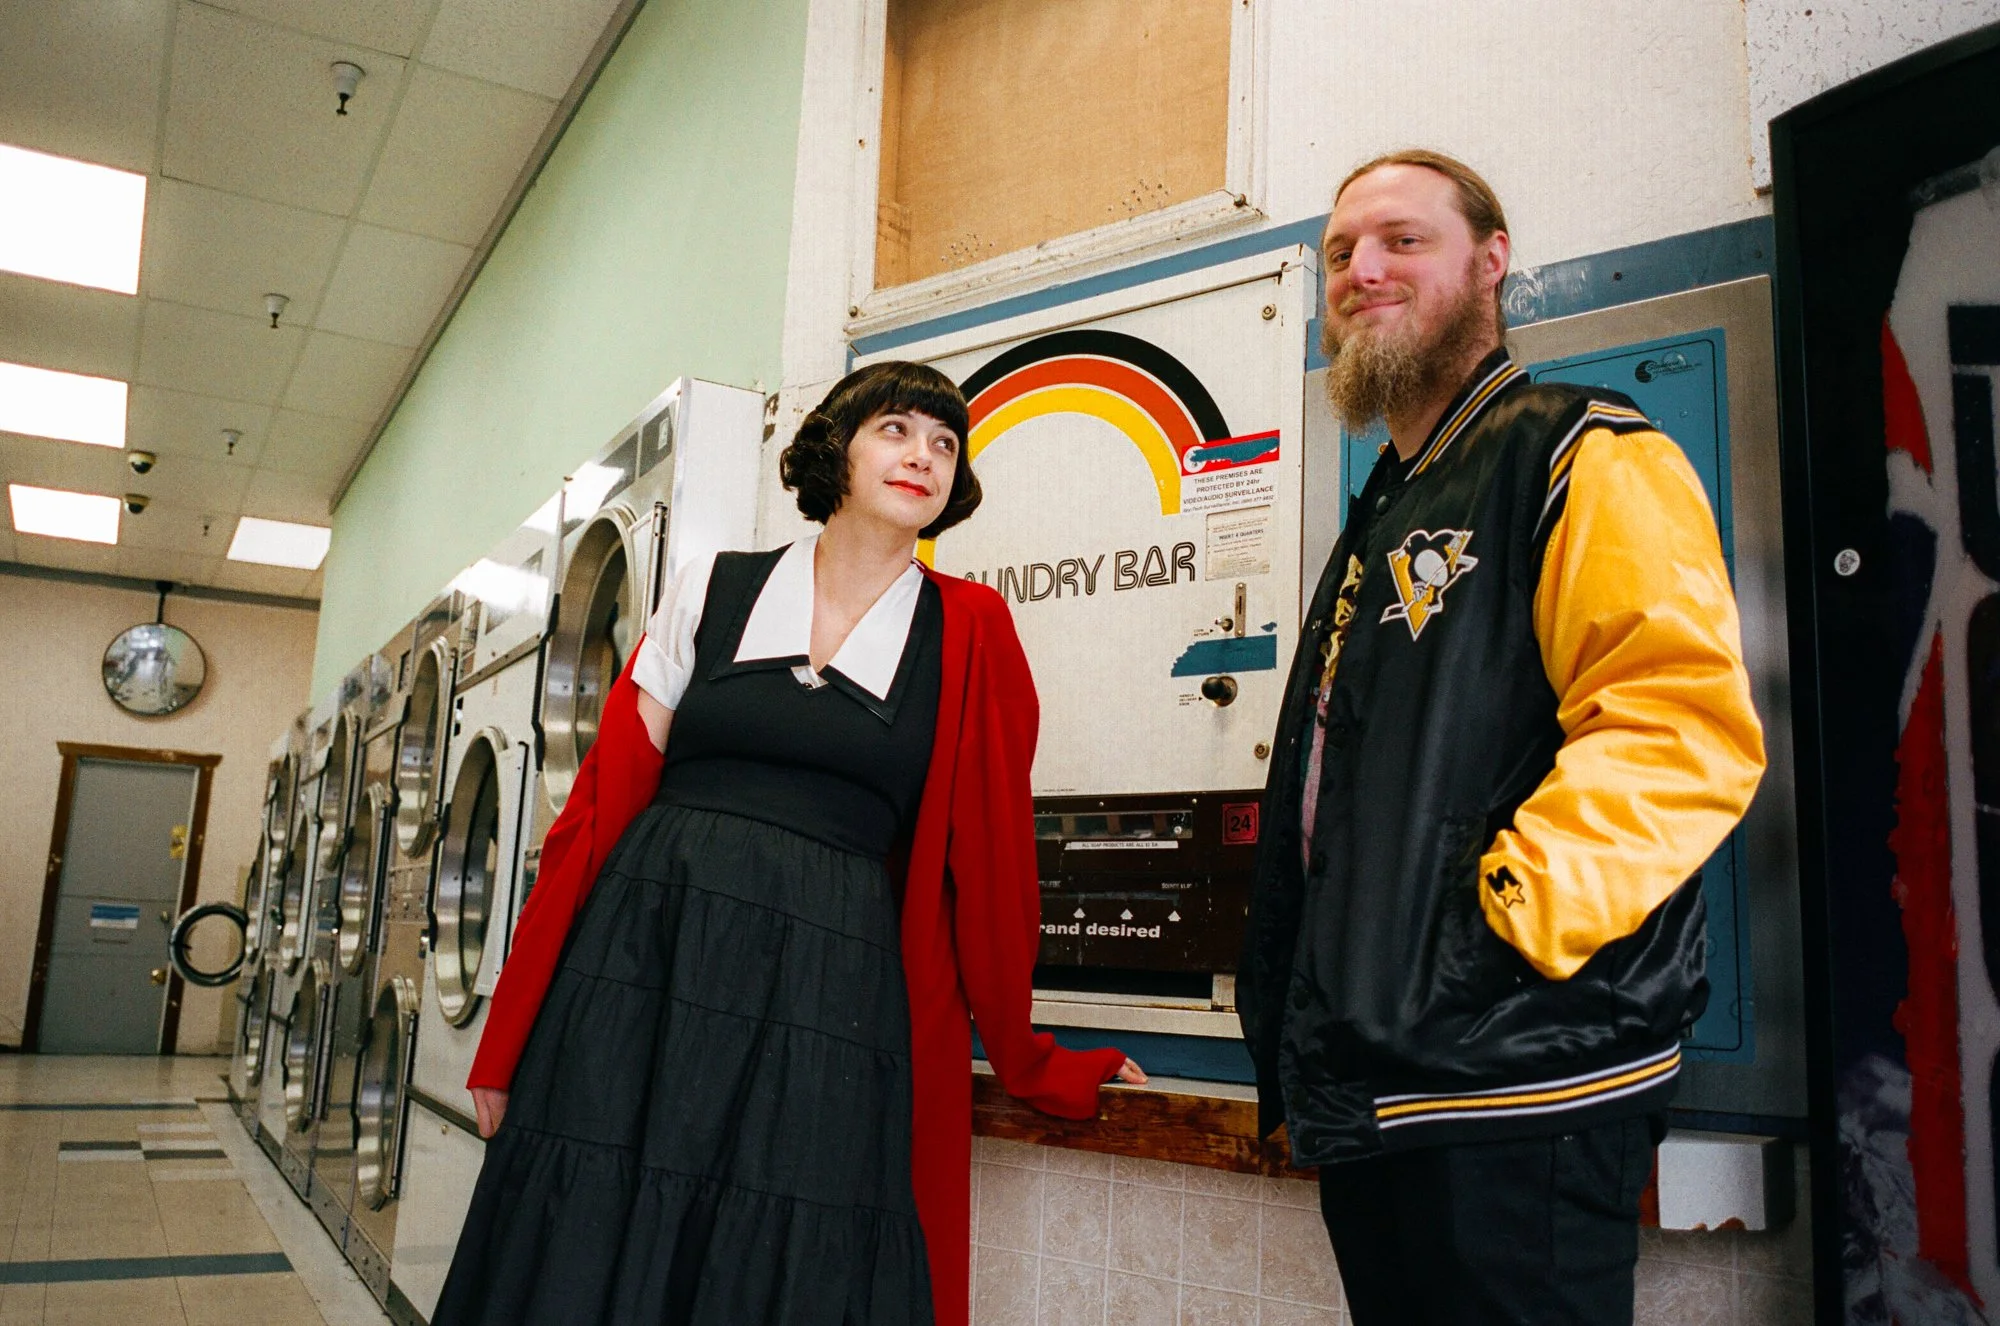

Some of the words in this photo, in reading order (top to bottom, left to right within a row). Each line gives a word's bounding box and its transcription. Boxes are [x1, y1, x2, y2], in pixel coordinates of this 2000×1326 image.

[1194, 475, 1214, 484] THESE
[1216, 471, 1248, 481] PREMISES
[1196, 481, 1234, 493] PROTECTED
[1236, 480, 1245, 489] BY
[1246, 478, 1260, 486] 24hr
[1224, 485, 1274, 499] SURVEILLANCE
[1240, 528, 1264, 537] QUARTERS
[1114, 541, 1196, 591] BAR
[1230, 815, 1252, 832] 24
[1085, 922, 1161, 938] desired
